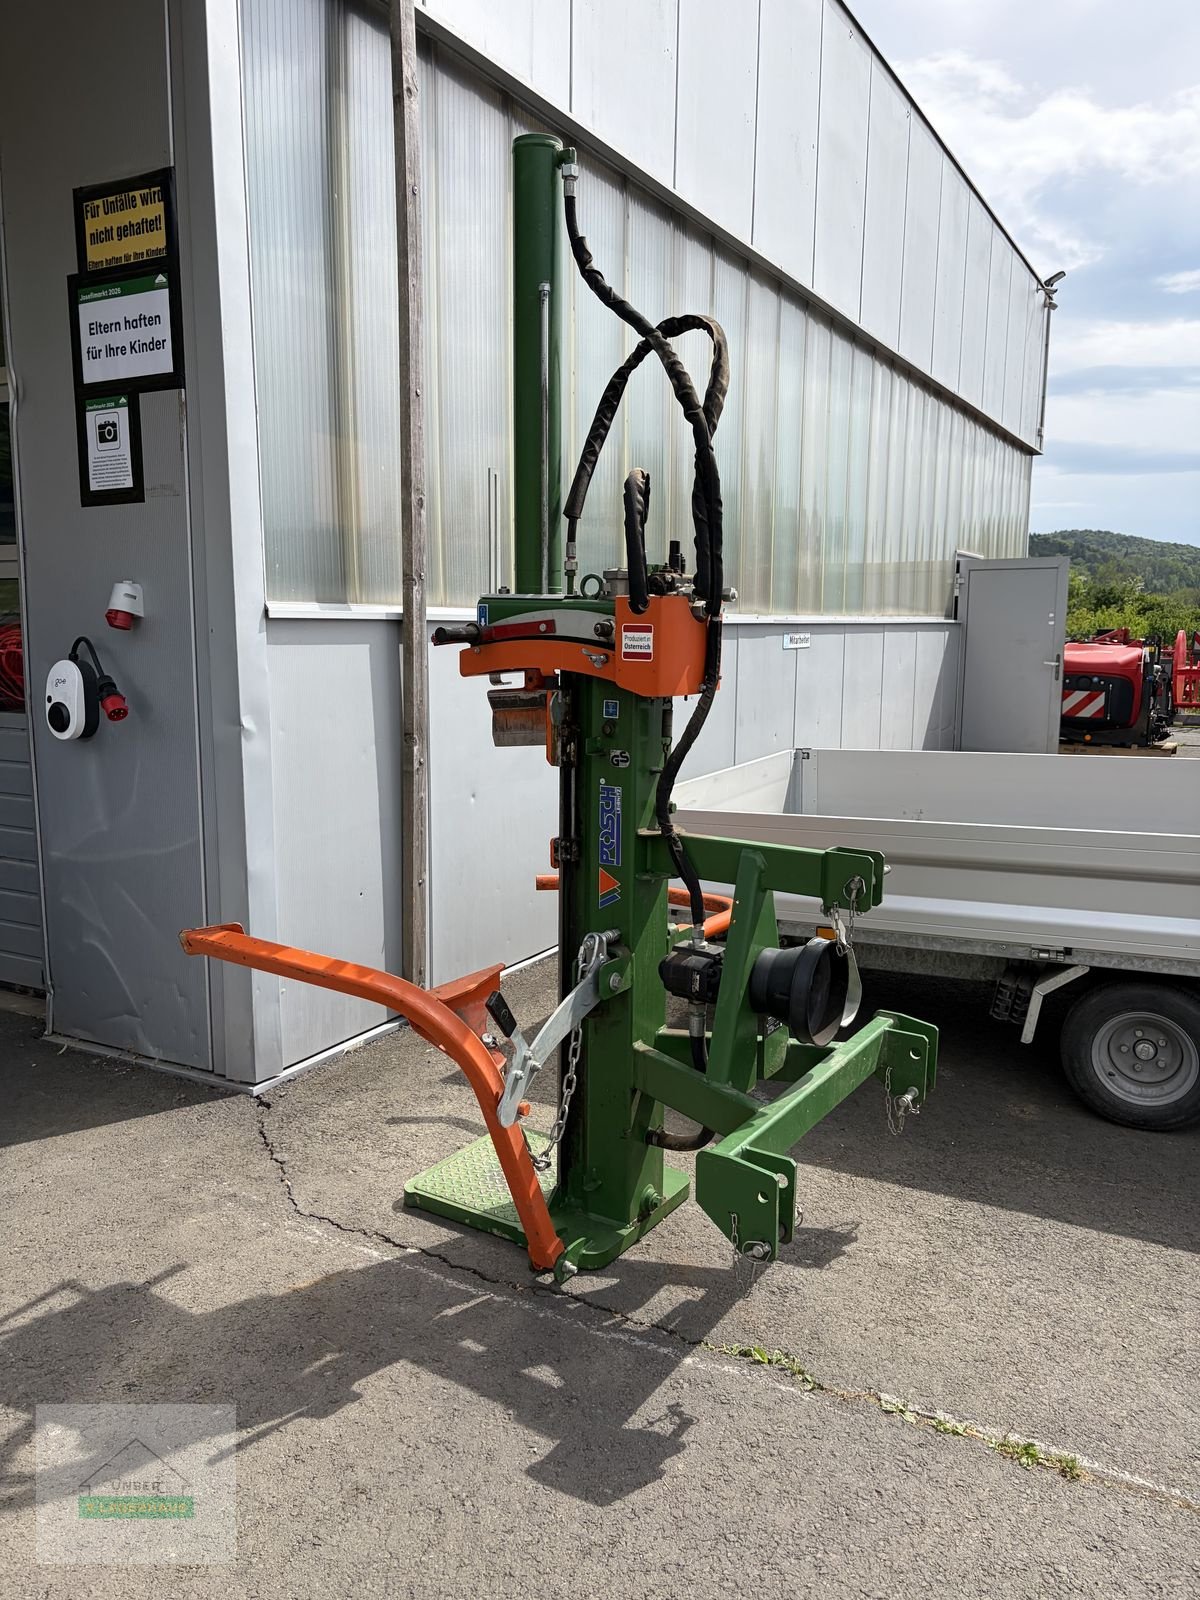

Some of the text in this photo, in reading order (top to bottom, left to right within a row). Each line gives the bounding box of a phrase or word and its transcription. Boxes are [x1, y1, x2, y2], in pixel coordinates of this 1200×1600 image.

[84, 203, 100, 220] Für
[102, 193, 138, 216] Unfälle
[89, 213, 162, 246] nicht gehaftet!
[105, 256, 122, 267] haften
[123, 253, 132, 263] für
[133, 250, 145, 261] Ihre
[88, 313, 161, 336] Eltern haften
[86, 337, 167, 360] für Ihre Kinder
[611, 751, 630, 766] GS
[599, 785, 616, 865] POSCH
